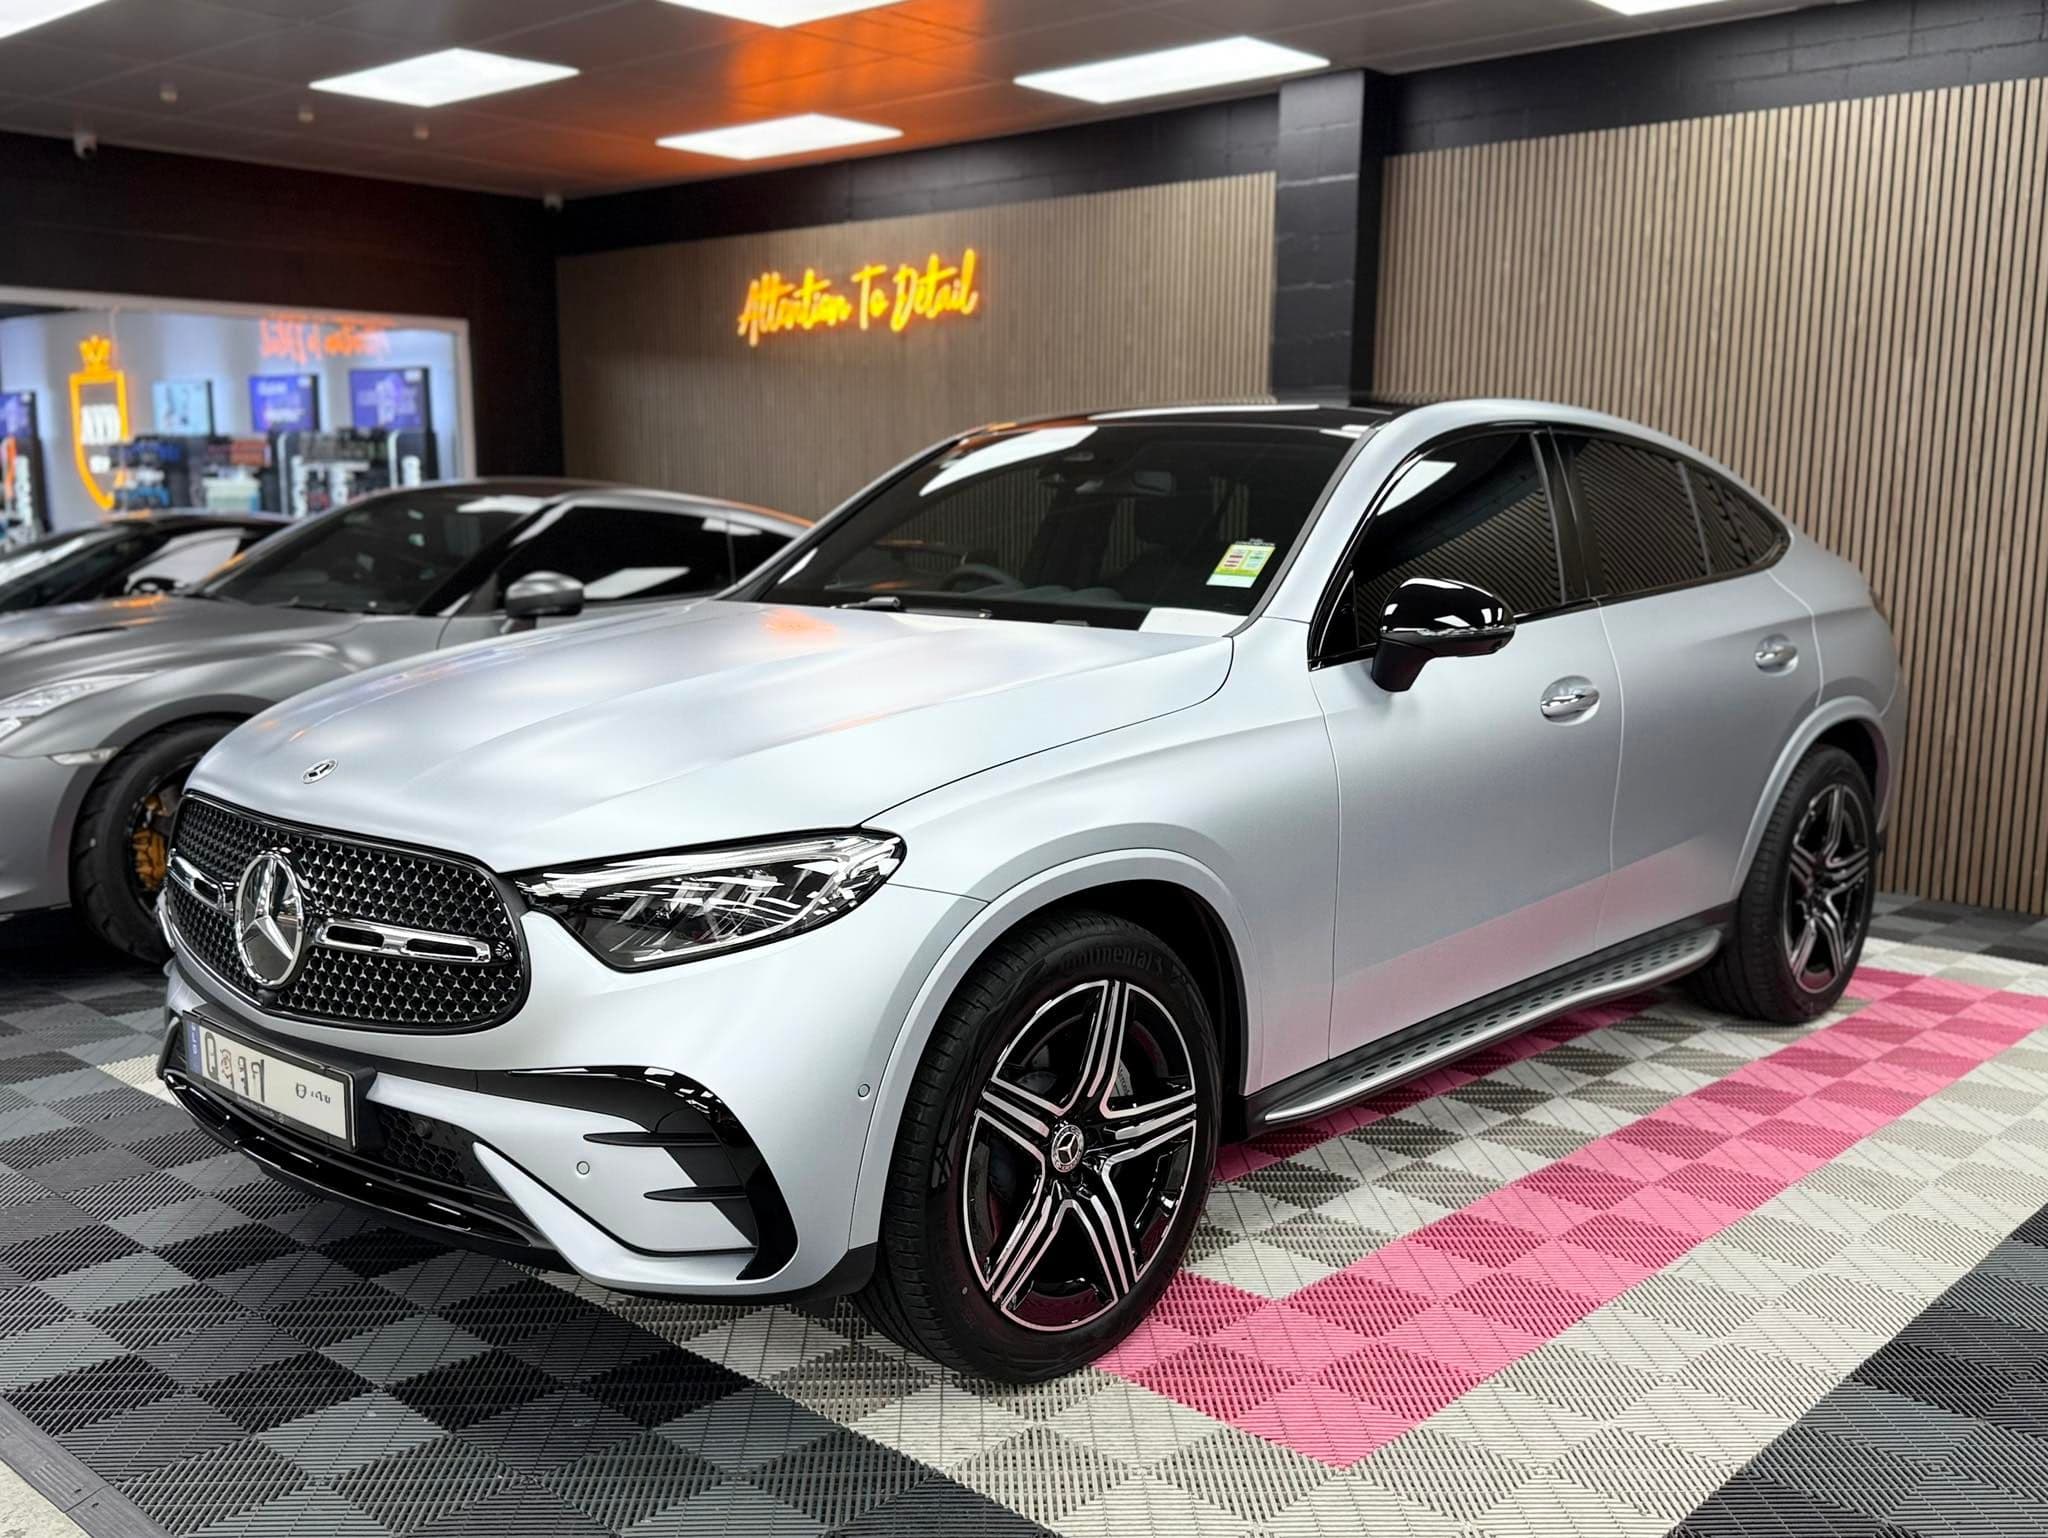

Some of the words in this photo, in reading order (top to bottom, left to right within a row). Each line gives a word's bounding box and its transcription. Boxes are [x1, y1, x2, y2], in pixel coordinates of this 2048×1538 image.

[737, 268, 852, 347] Attention
[851, 263, 888, 331] To
[890, 248, 980, 333] Detail
